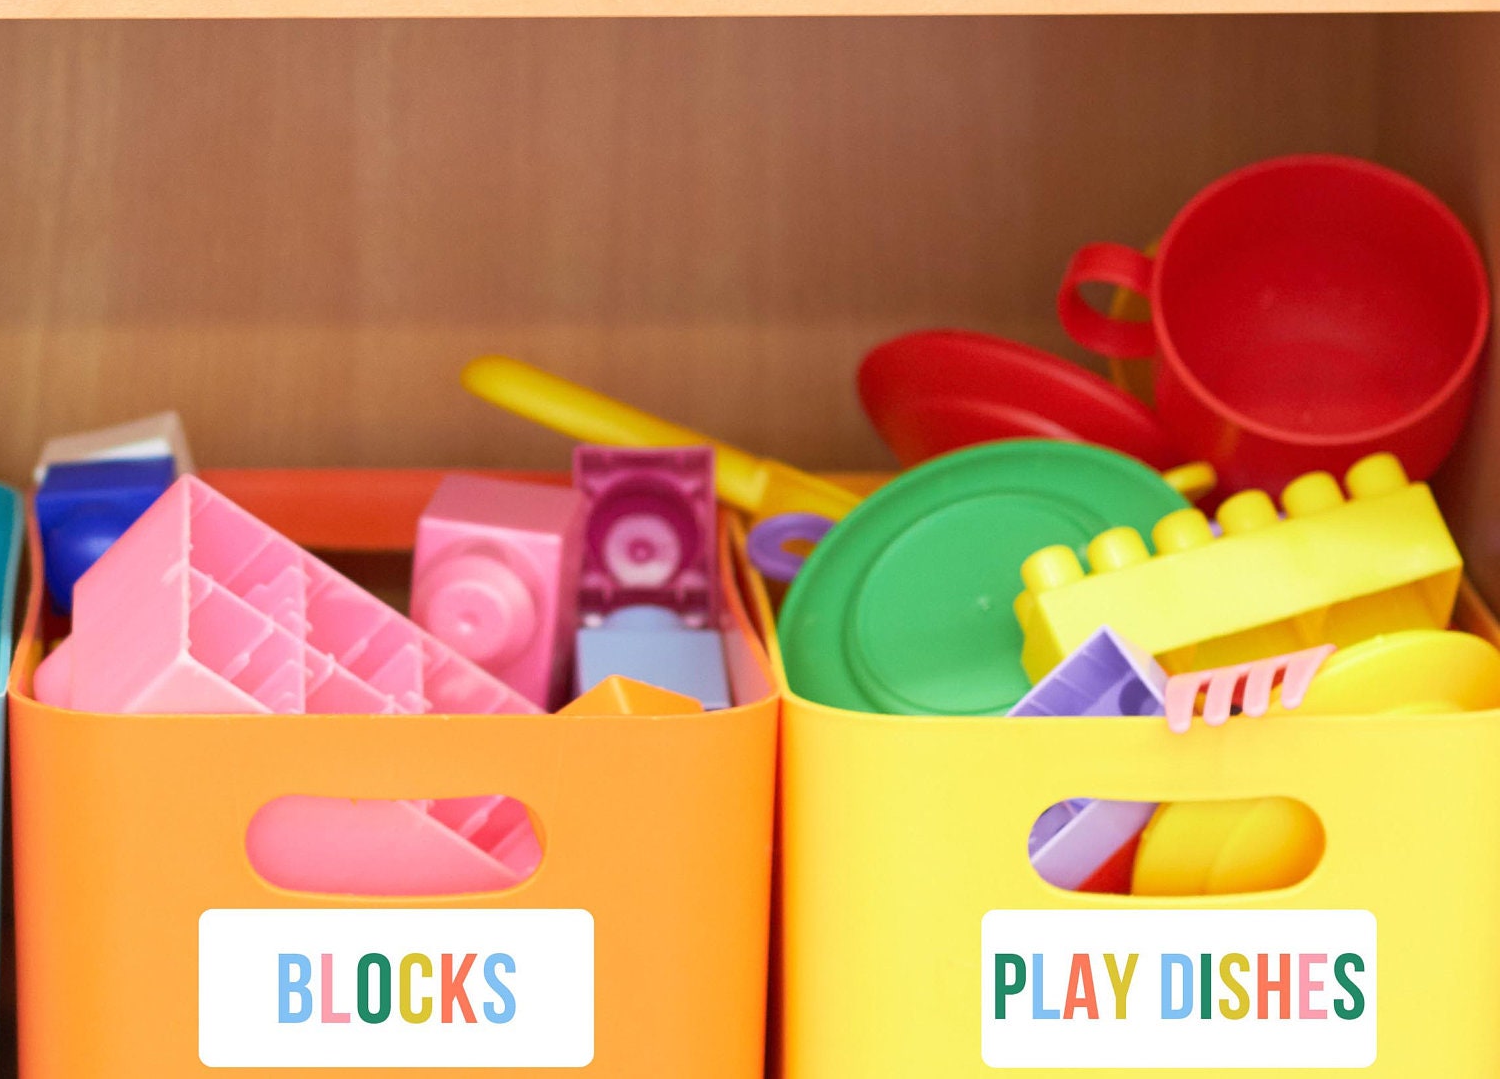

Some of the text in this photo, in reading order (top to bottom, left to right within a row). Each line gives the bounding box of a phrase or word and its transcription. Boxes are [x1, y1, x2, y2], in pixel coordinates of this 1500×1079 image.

[277, 951, 517, 1025] BLOCKS
[994, 951, 1366, 1021] PLAY DISHES
